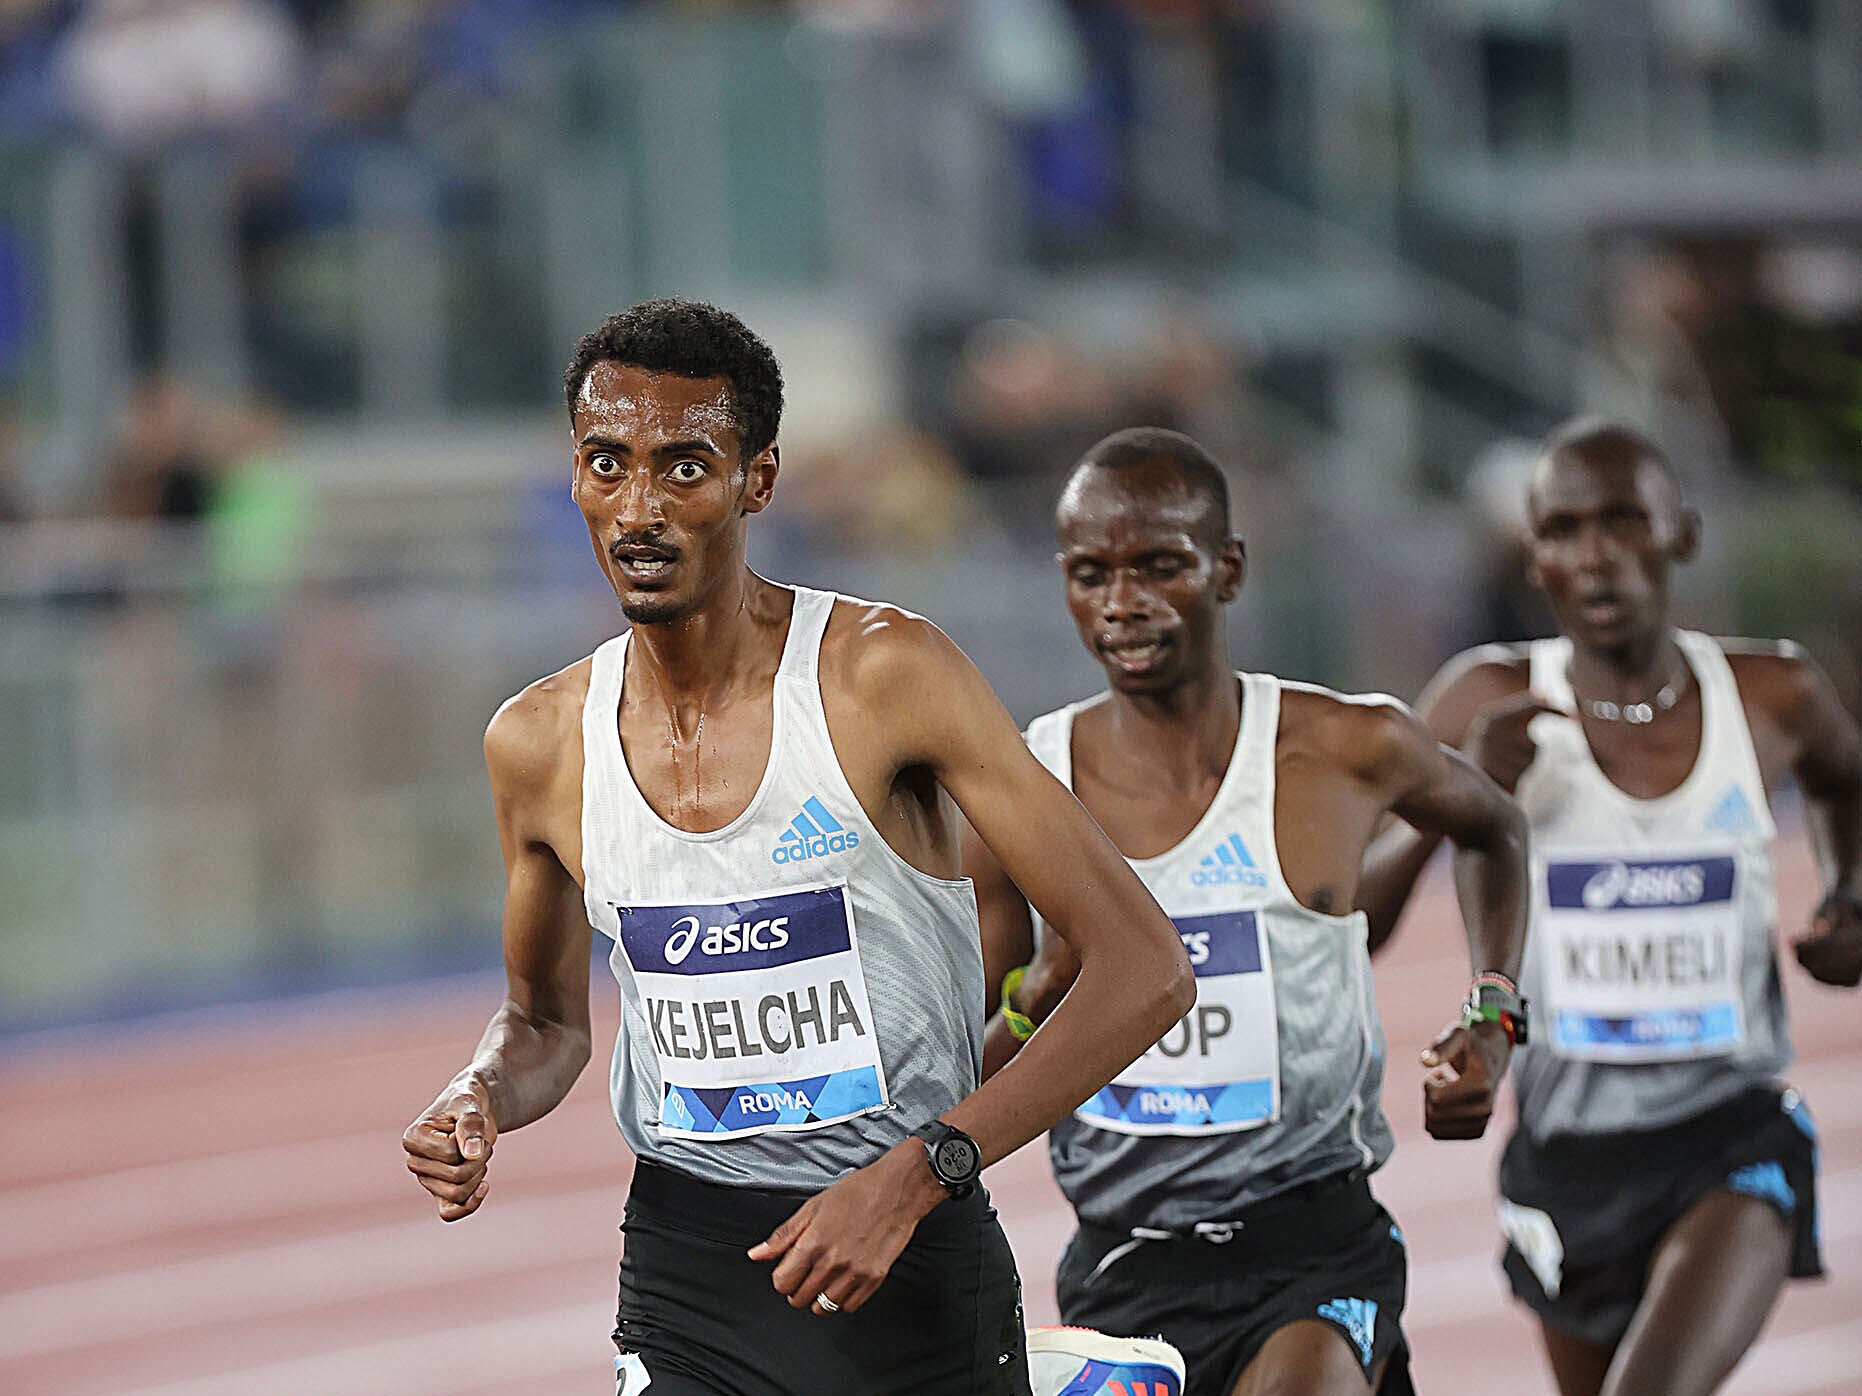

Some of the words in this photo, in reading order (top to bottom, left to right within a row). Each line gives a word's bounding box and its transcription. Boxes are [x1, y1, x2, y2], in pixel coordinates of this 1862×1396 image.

[772, 831, 860, 864] adidas
[1190, 866, 1268, 889] adidas
[646, 979, 866, 1061] KEJELCHA
[1147, 1005, 1232, 1059] OP
[738, 1089, 813, 1115] ROMA
[1140, 1091, 1213, 1116] ROMA
